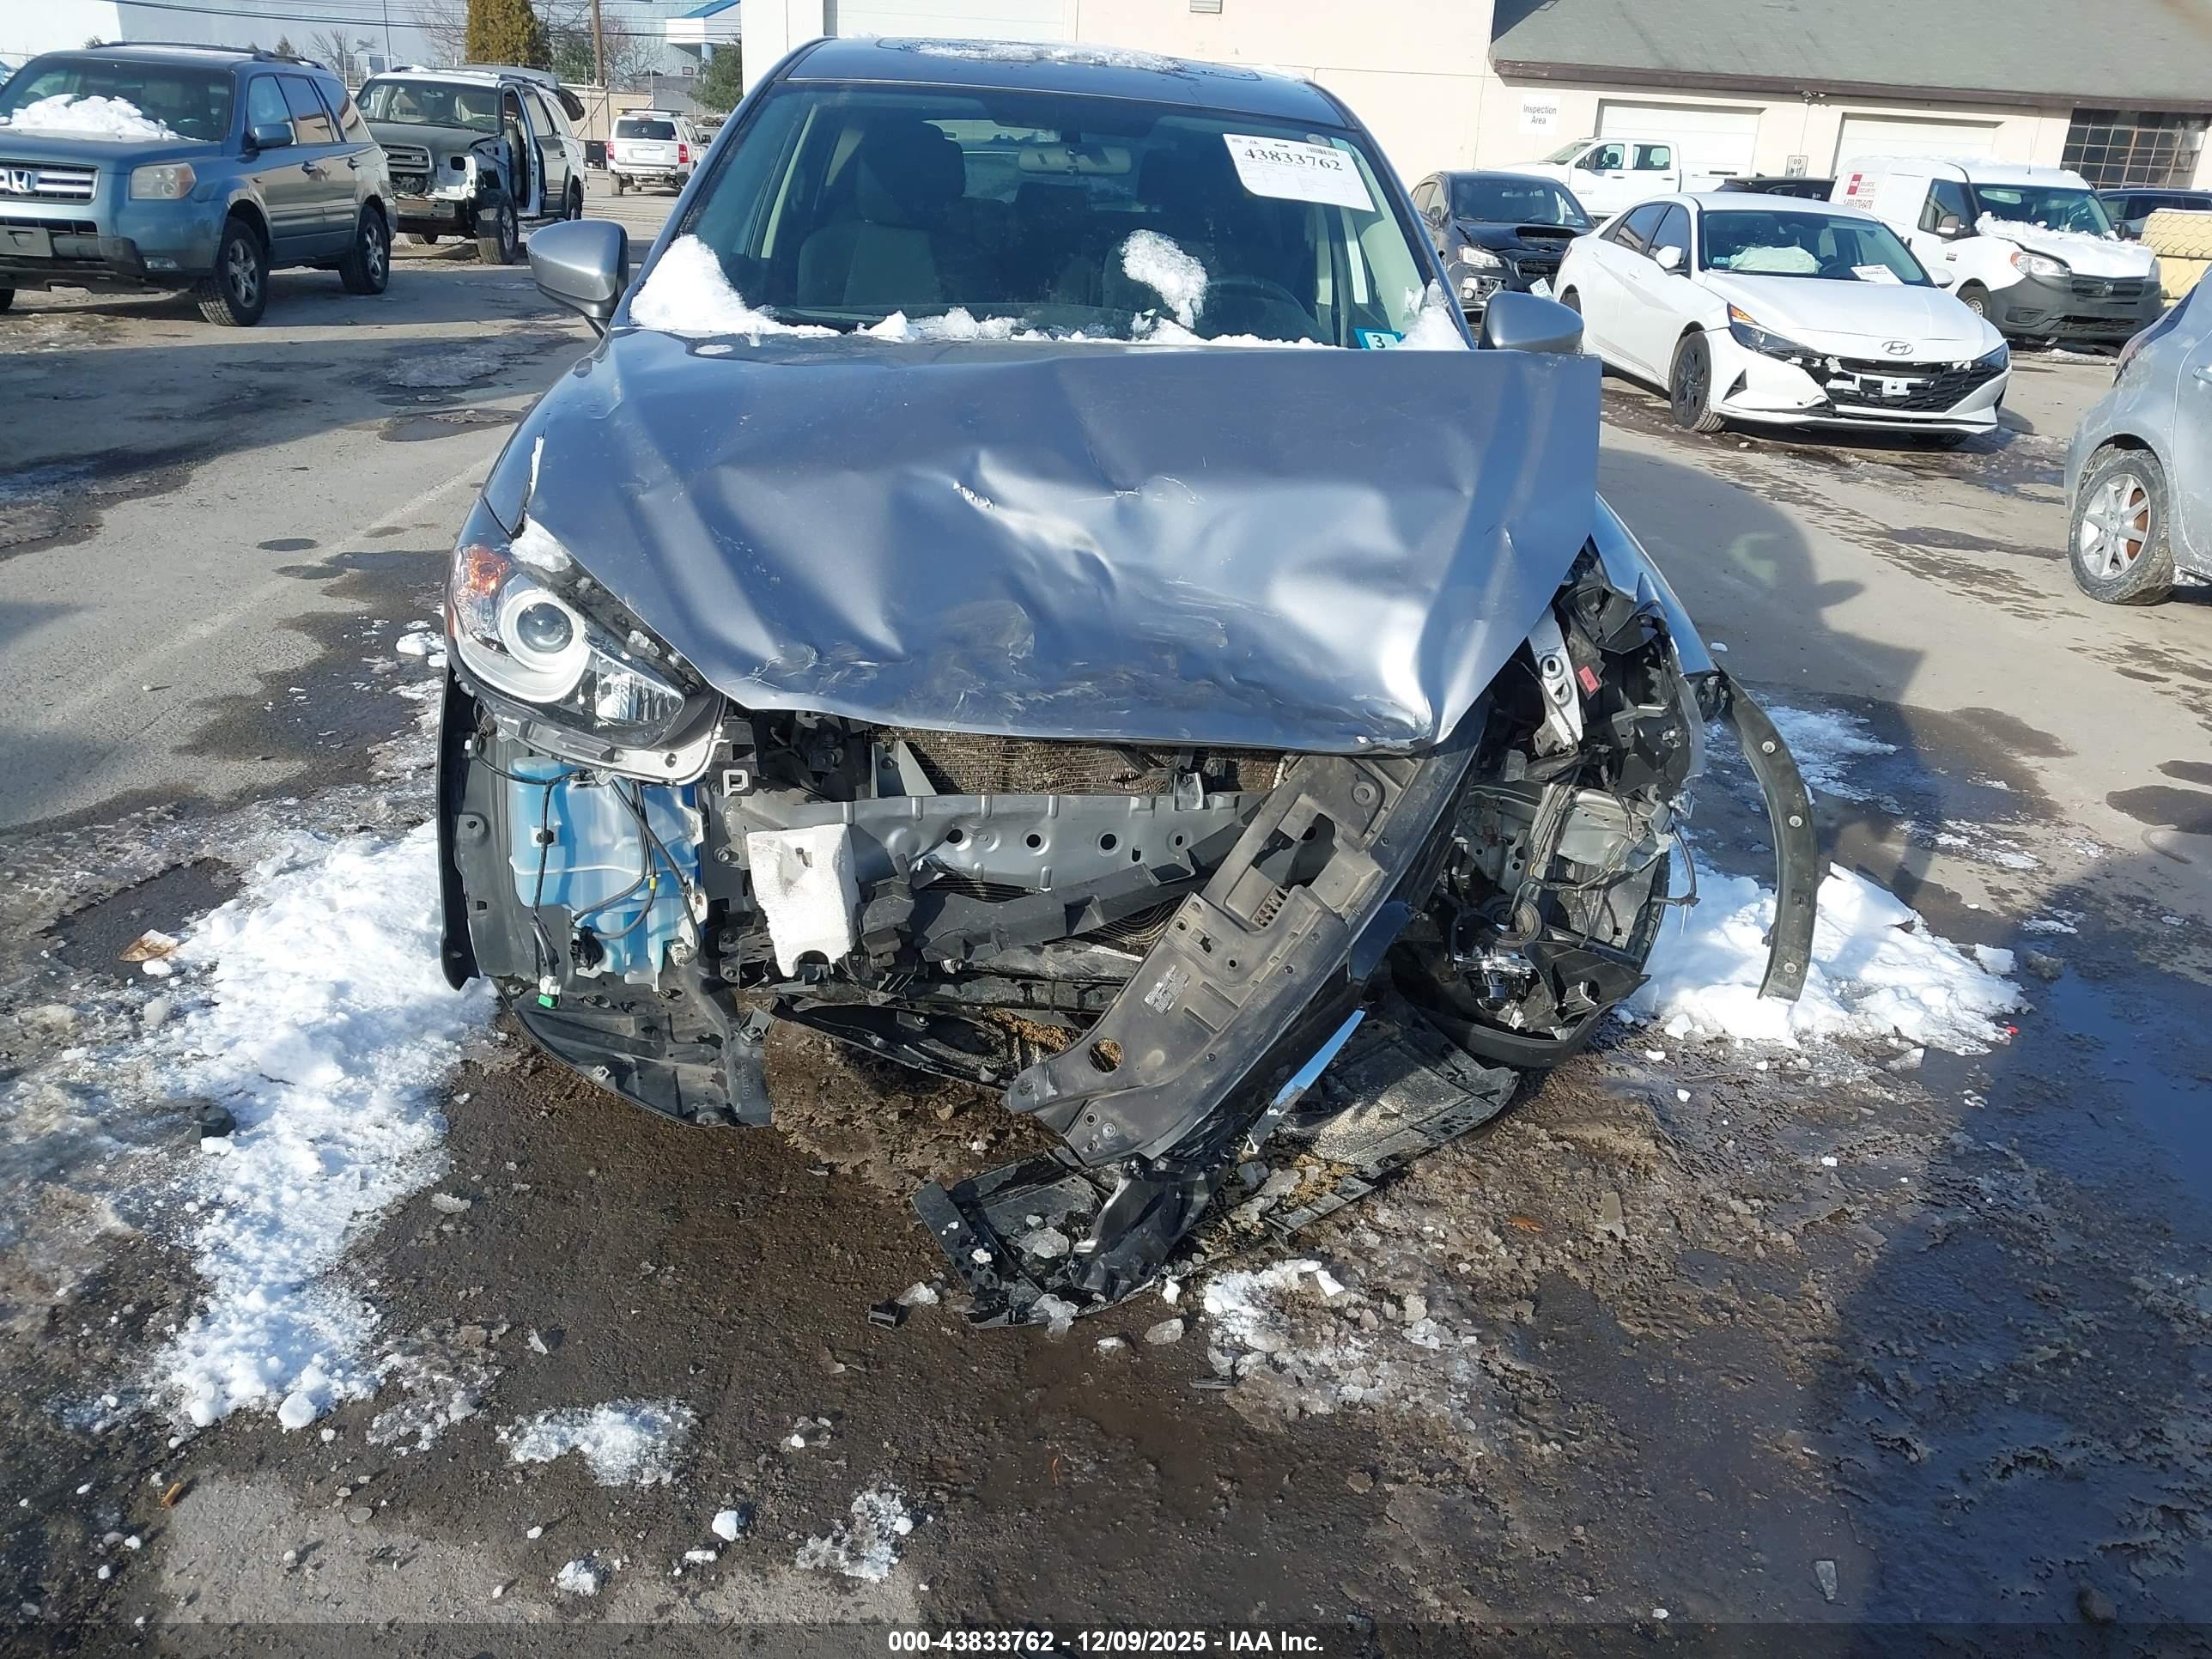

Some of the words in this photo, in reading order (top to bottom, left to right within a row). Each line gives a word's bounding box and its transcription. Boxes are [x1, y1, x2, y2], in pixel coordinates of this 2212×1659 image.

[1523, 104, 1557, 115] Inspection
[1530, 115, 1547, 125] Area
[1244, 147, 1343, 171] 43833762
[1372, 334, 1386, 349] 3
